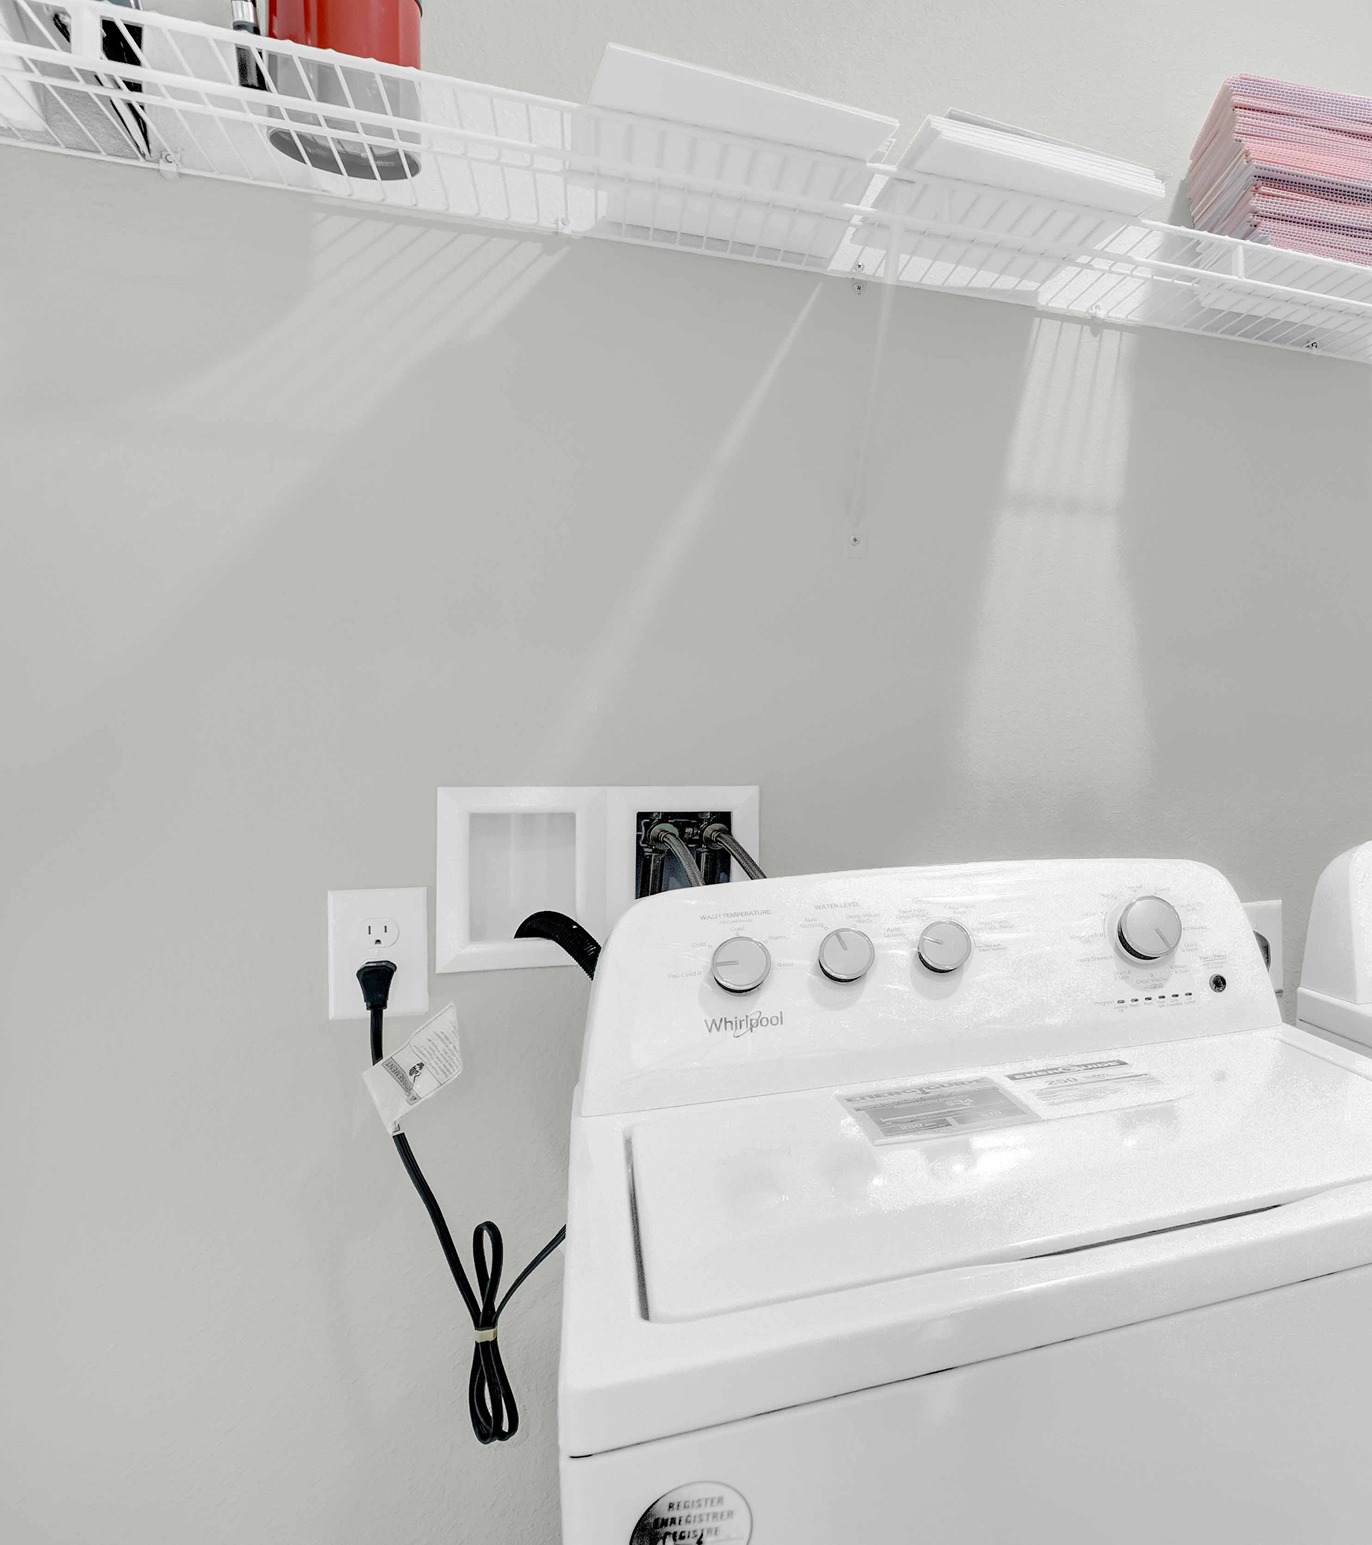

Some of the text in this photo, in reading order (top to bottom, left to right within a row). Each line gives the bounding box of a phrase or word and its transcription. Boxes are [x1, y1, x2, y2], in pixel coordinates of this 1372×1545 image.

[722, 910, 771, 918] TEMPERATURE
[704, 1011, 783, 1036] Whirlpool
[667, 1496, 724, 1512] REGISTER
[653, 1510, 734, 1529] ENREGISTRER
